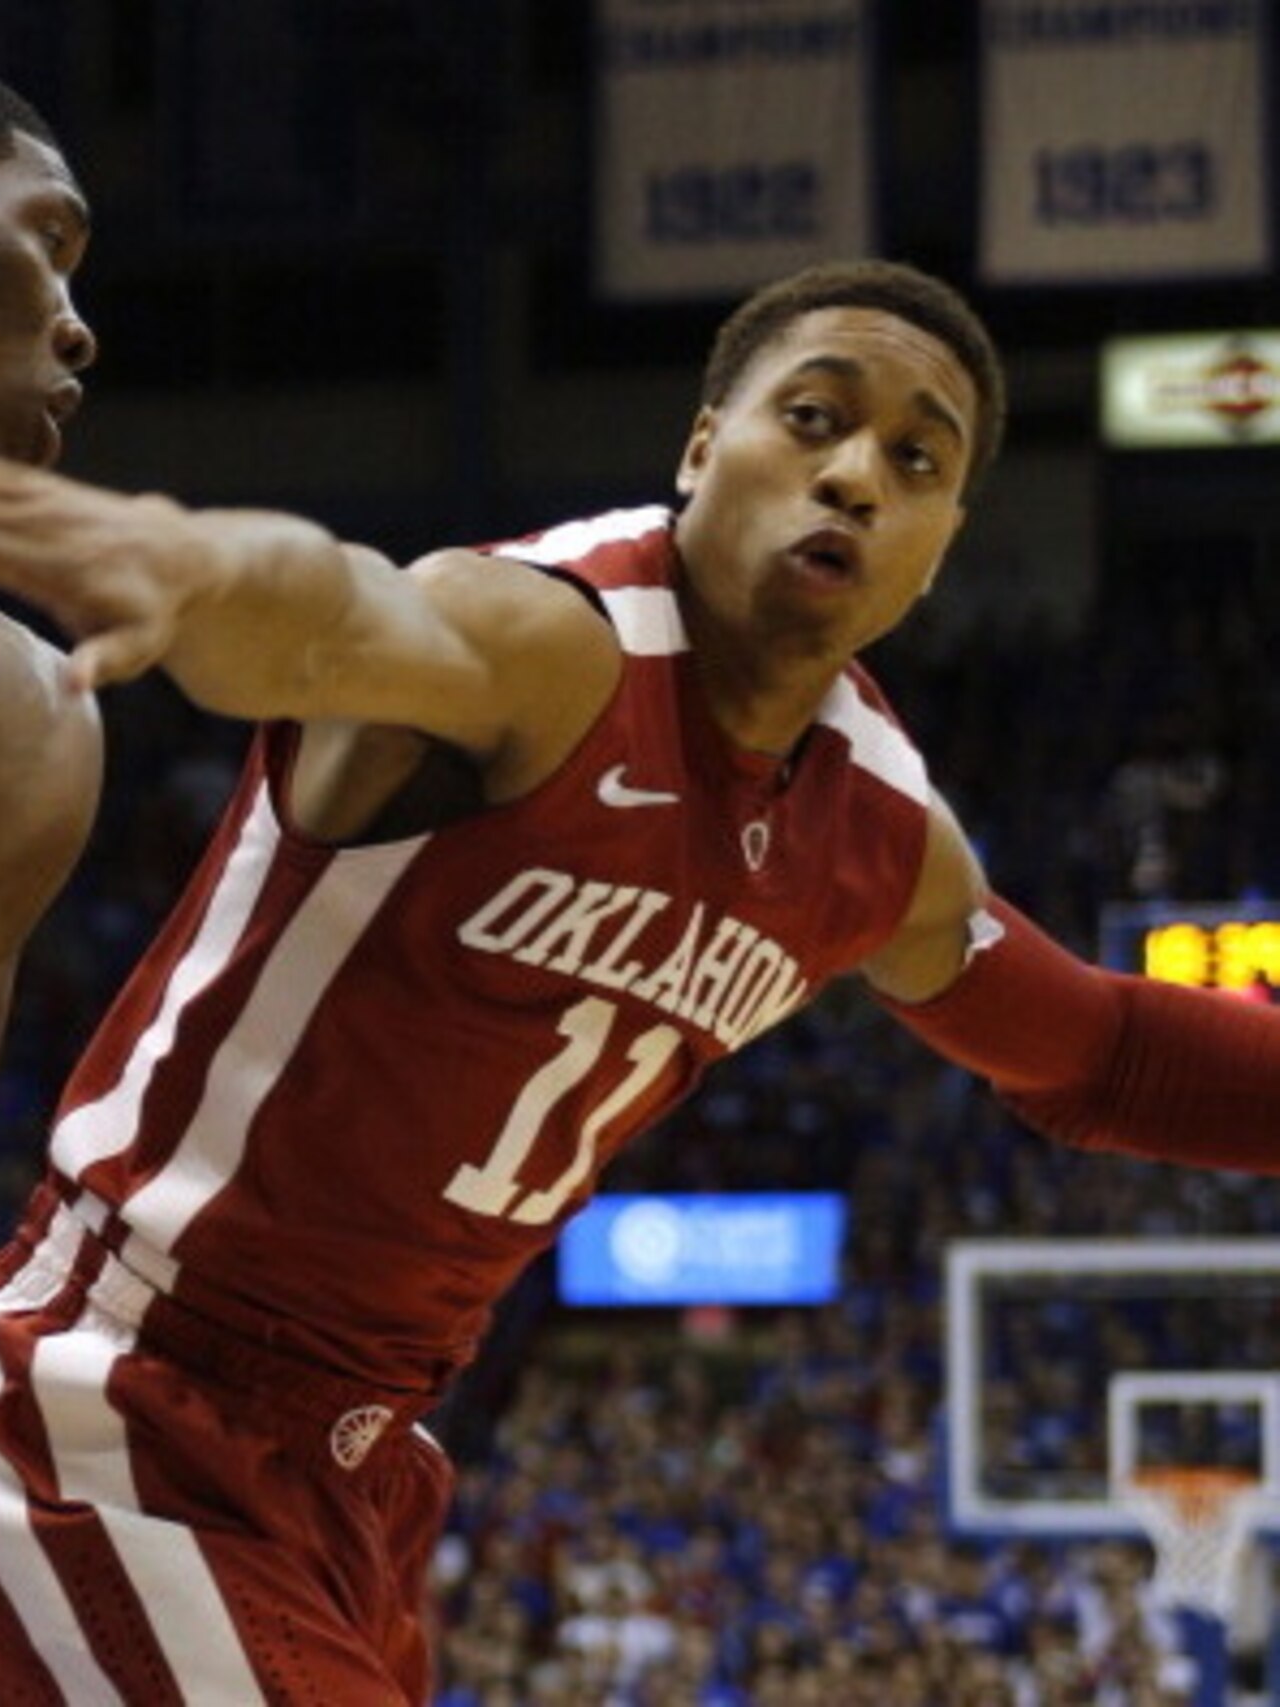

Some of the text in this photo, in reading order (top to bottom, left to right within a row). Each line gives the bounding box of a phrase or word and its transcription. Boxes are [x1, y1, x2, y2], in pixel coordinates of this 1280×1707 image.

[646, 163, 818, 246] 1922
[1034, 143, 1214, 227] 1923
[457, 867, 808, 1052] OKLAHOM
[443, 996, 682, 1225] 11
